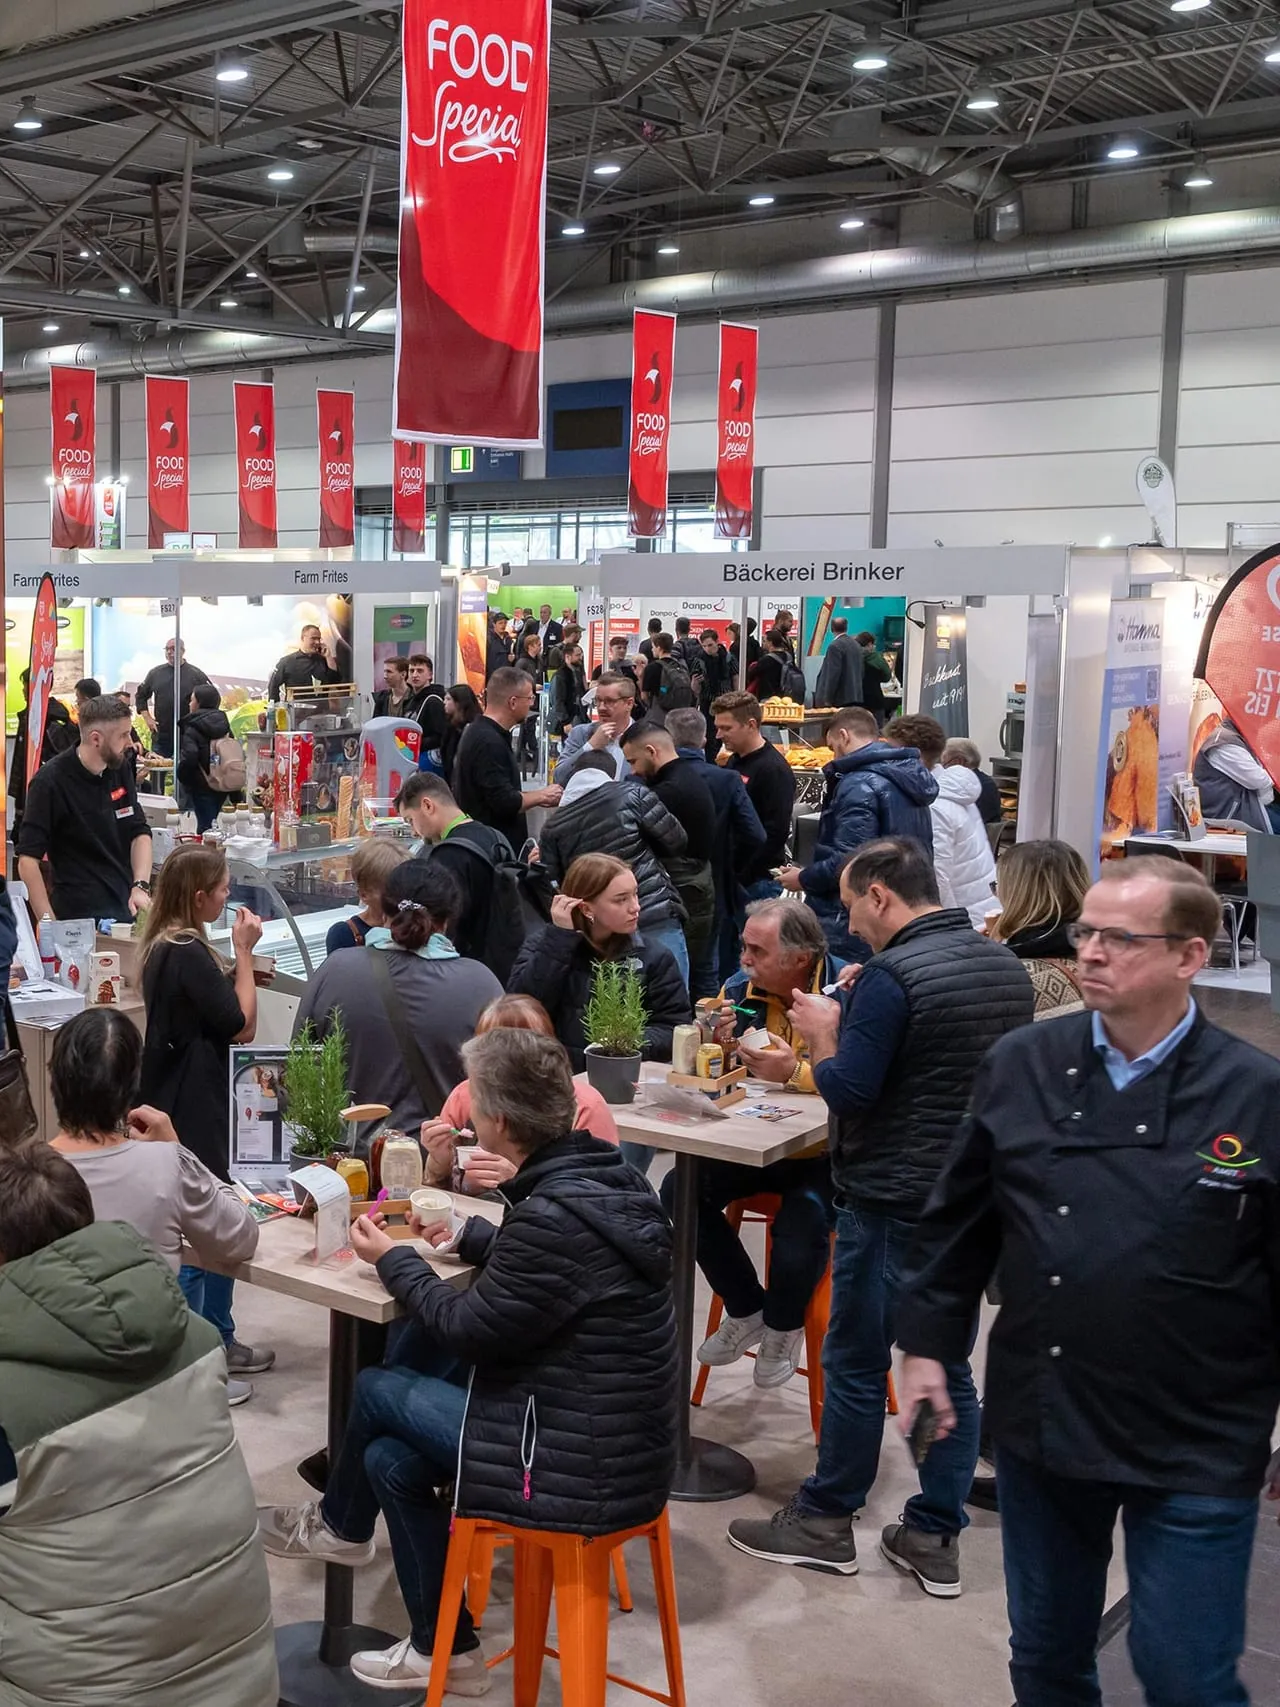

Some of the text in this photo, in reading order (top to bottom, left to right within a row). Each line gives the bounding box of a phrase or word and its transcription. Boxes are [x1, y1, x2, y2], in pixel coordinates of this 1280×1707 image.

[427, 18, 533, 93] FOOD
[411, 80, 525, 168] Special
[636, 413, 666, 431] FOOD
[724, 420, 752, 437] FOOD
[634, 430, 665, 457] Special
[720, 437, 750, 461] Special
[58, 448, 92, 464] FOOD
[156, 456, 185, 470] FOOD
[245, 458, 275, 471] FOOD
[56, 463, 92, 481] Special
[325, 463, 352, 475] FOOD
[400, 467, 423, 479] FOOD
[154, 470, 185, 490] Special
[242, 472, 273, 491] Special
[324, 475, 352, 493] Special
[399, 479, 423, 497] Special
[51, 573, 80, 587] rites
[294, 569, 349, 583] Farm Frites
[723, 561, 905, 582] Bäckerei Brinker
[160, 604, 176, 613] FS27
[587, 600, 604, 616] FS28
[682, 602, 713, 611] Danpo
[767, 602, 799, 611] Danpo
